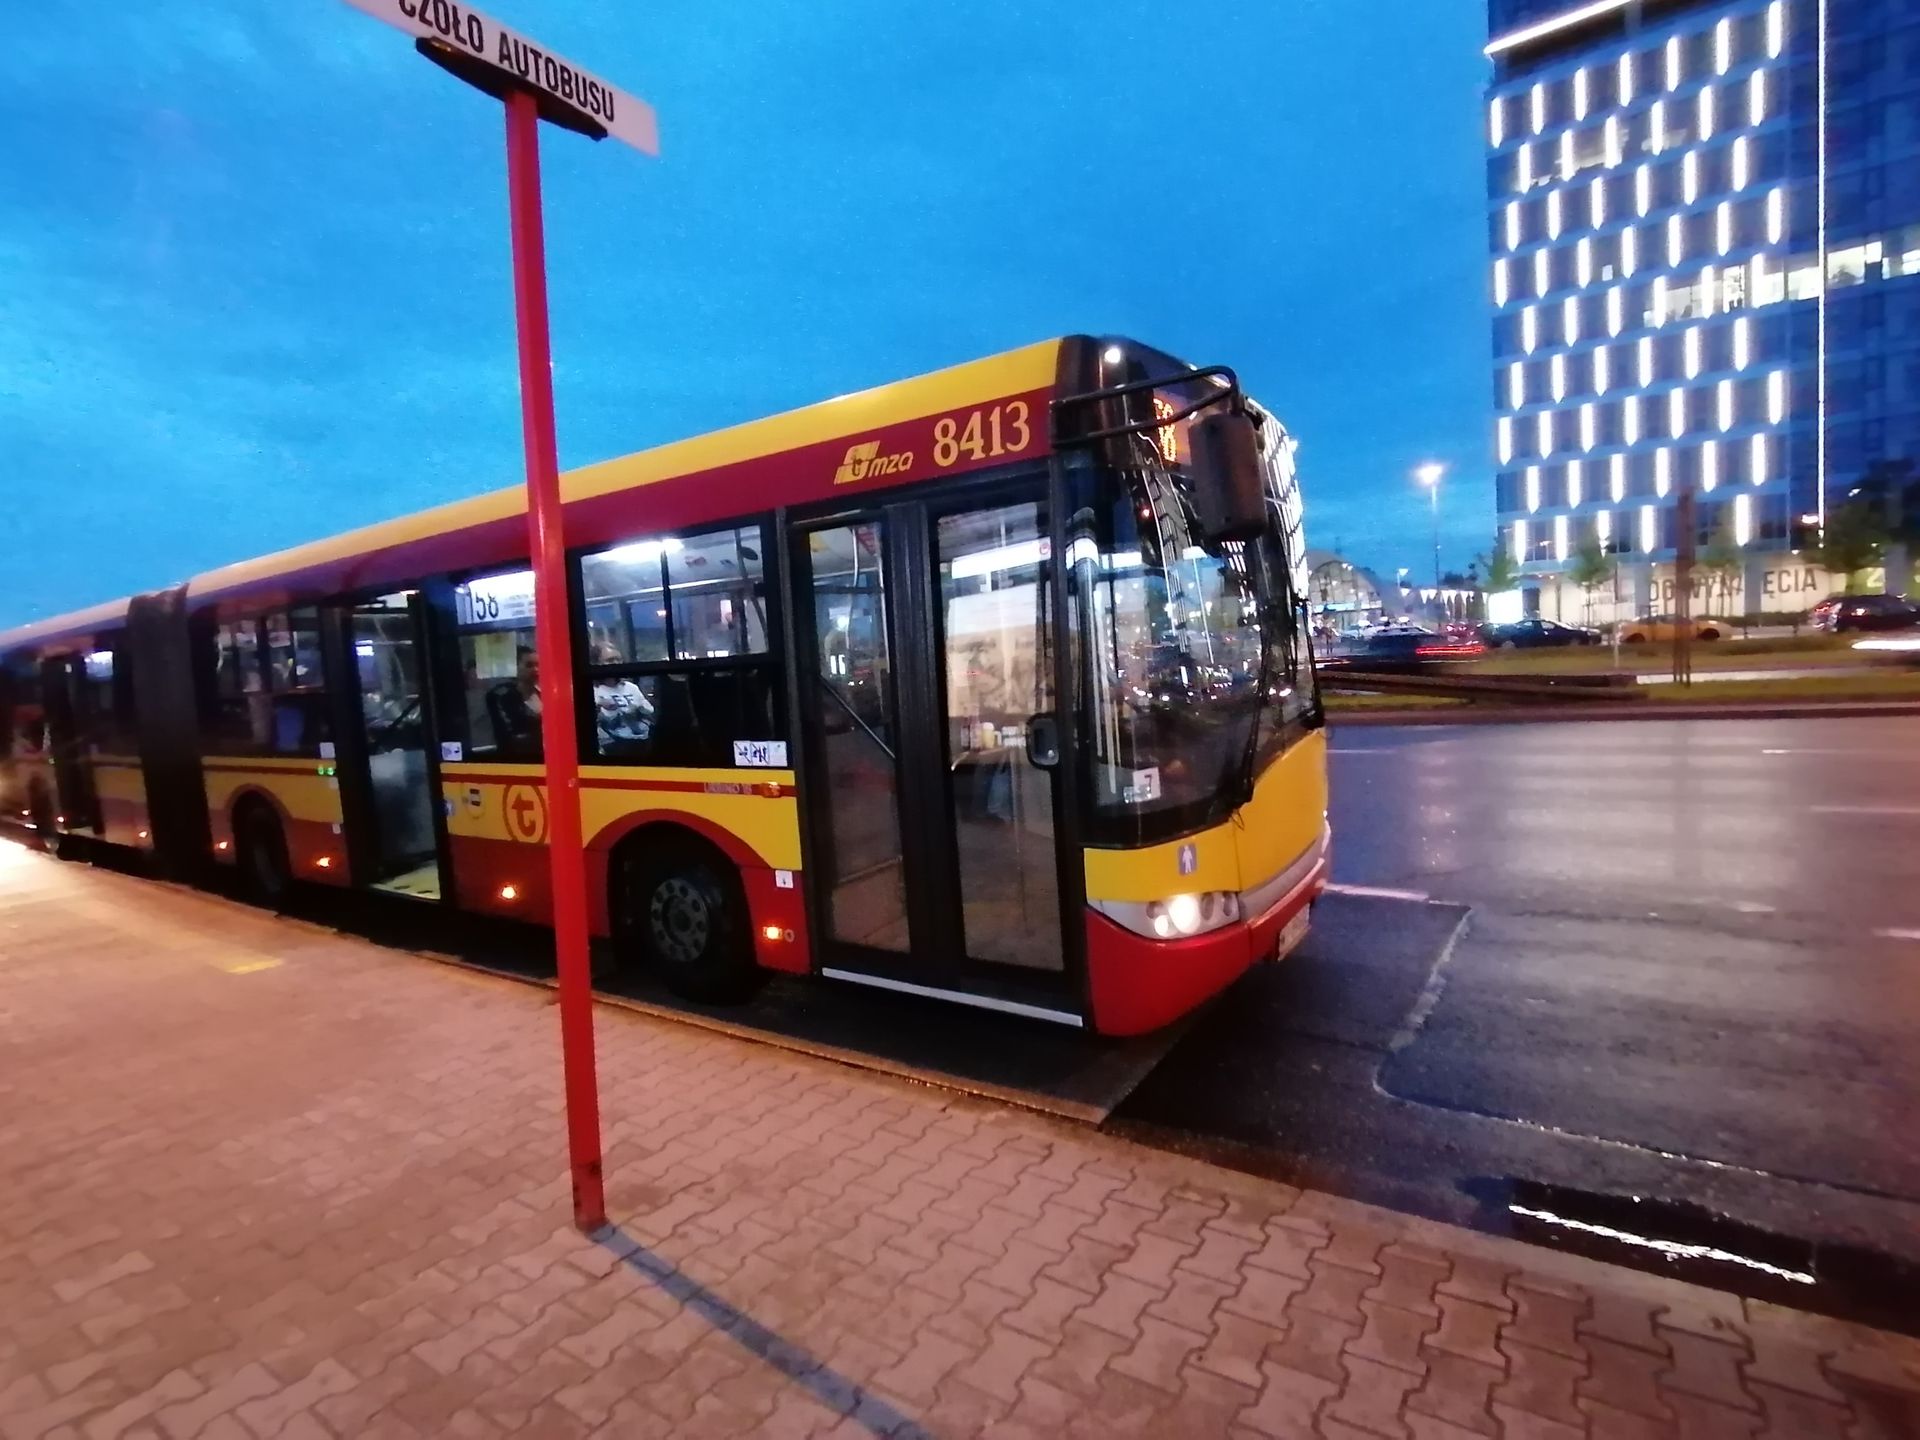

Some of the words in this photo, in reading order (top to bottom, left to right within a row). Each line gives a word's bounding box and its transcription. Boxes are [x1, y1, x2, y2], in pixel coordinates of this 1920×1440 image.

[499, 31, 615, 122] AUTOBUSU
[933, 401, 1030, 467] 8413
[1685, 567, 1817, 599] WYNAĘCIA
